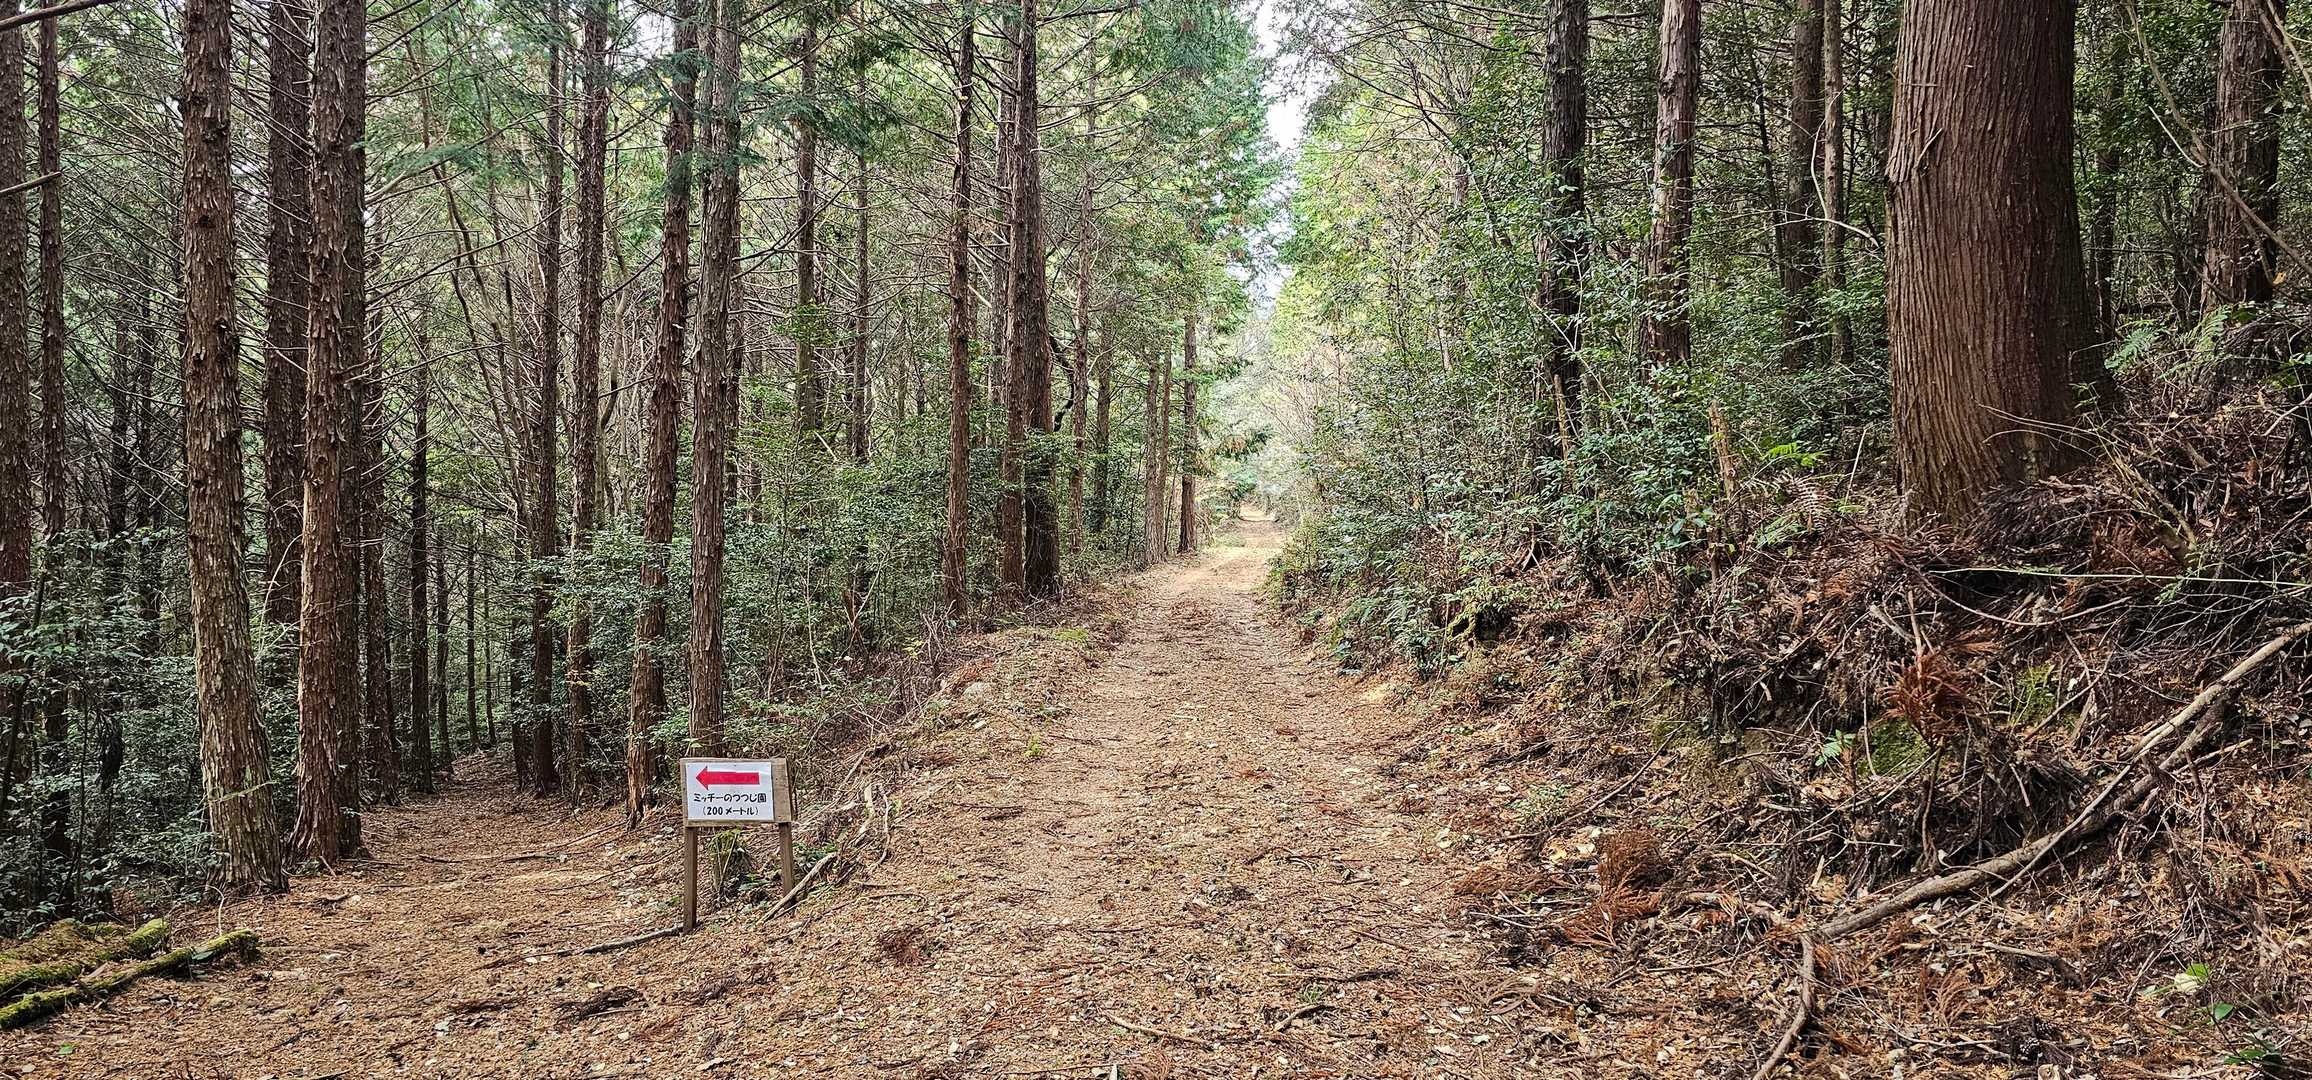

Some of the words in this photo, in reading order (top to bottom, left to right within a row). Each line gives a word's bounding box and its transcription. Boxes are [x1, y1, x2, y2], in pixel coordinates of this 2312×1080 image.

[693, 793, 767, 803] ミッチーのつつじ園
